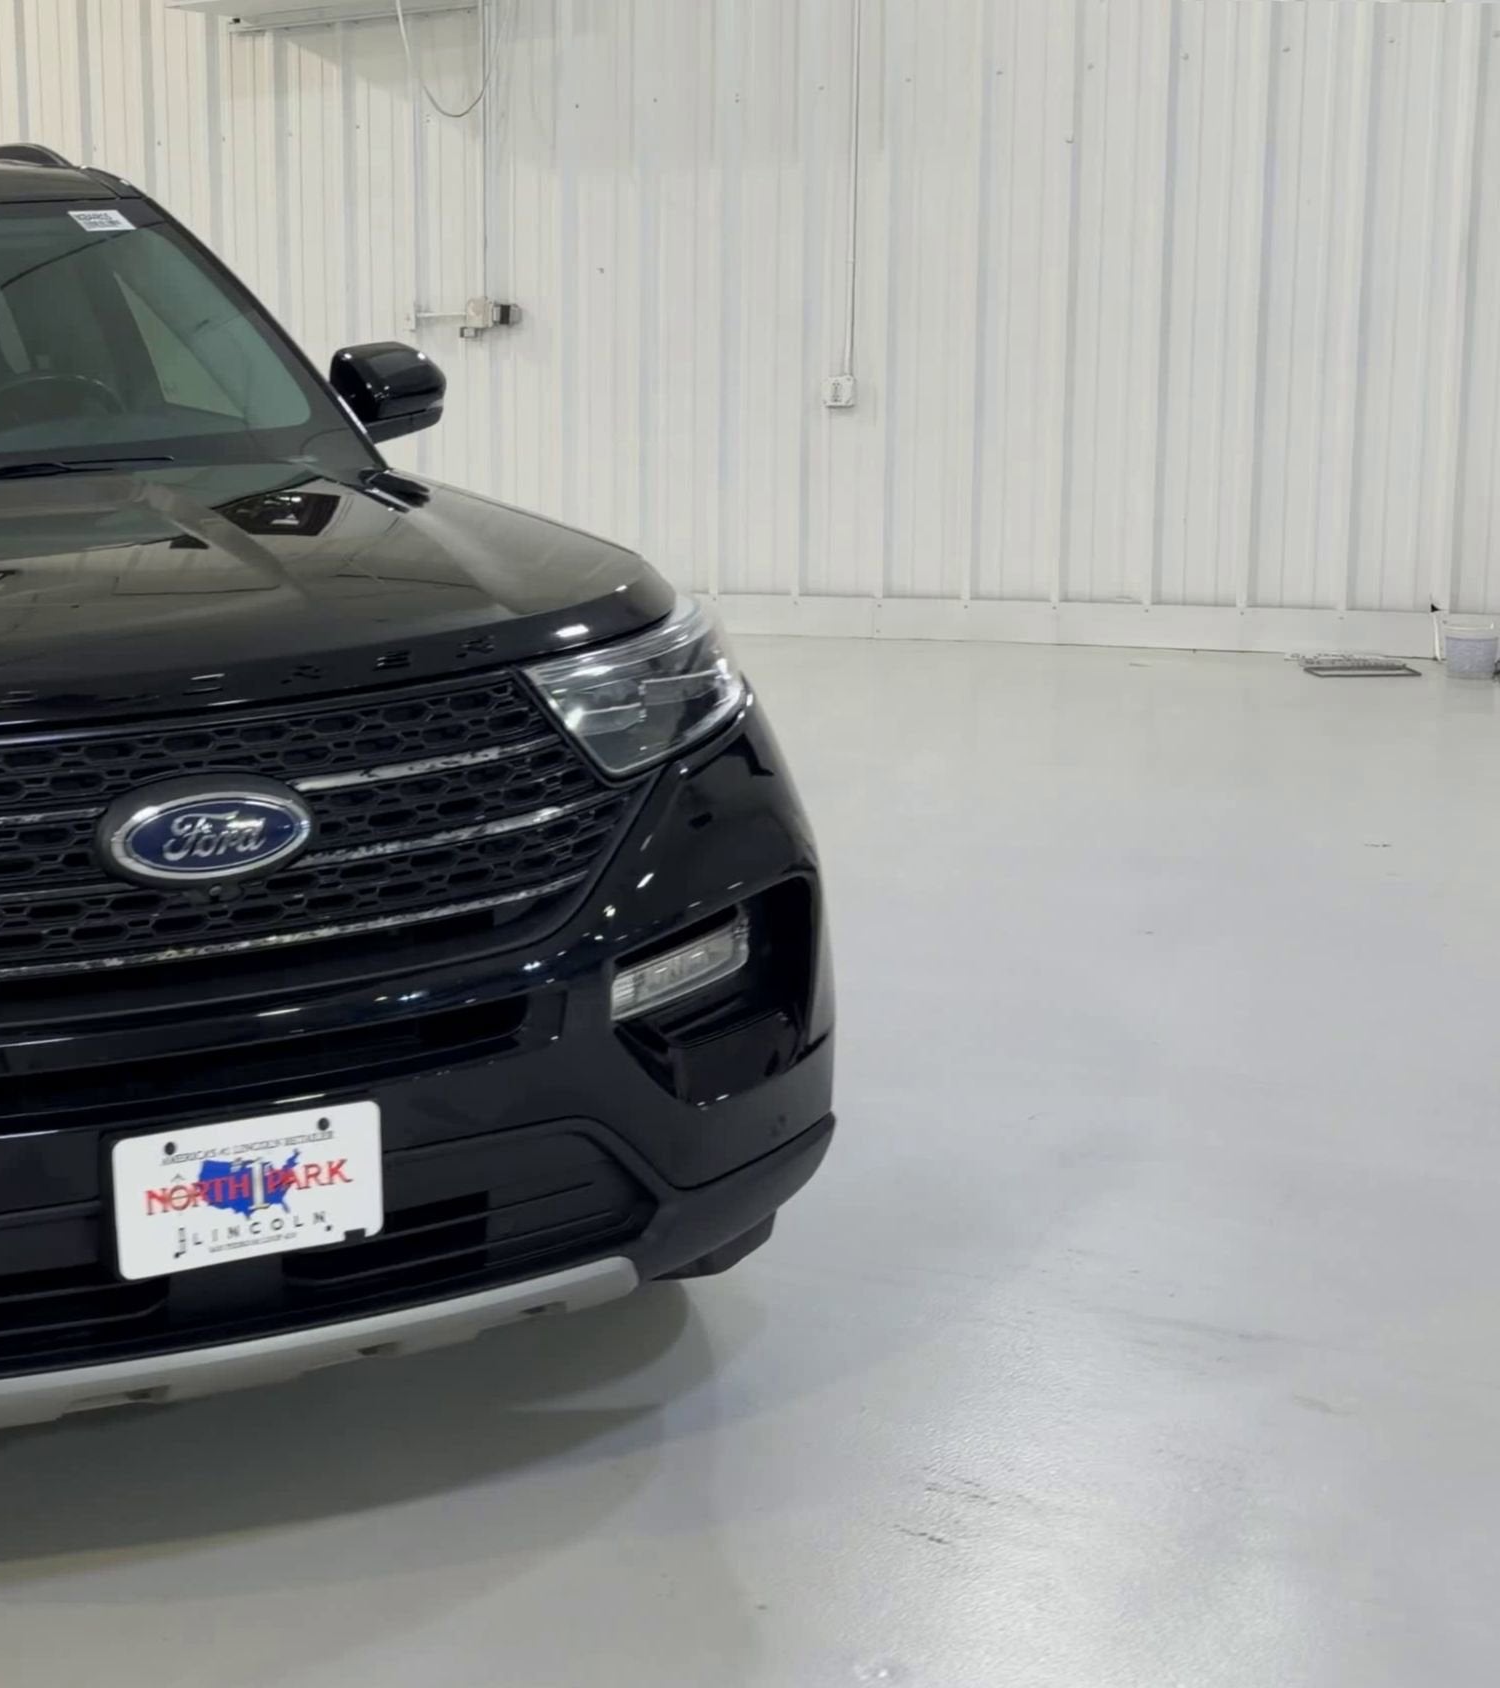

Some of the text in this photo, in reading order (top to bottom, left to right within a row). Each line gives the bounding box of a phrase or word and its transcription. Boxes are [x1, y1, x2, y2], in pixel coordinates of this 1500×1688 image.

[162, 811, 267, 861] Ford
[145, 1173, 251, 1216] NORTH
[267, 1158, 353, 1194] PARK
[192, 1211, 327, 1246] LINCOLN
